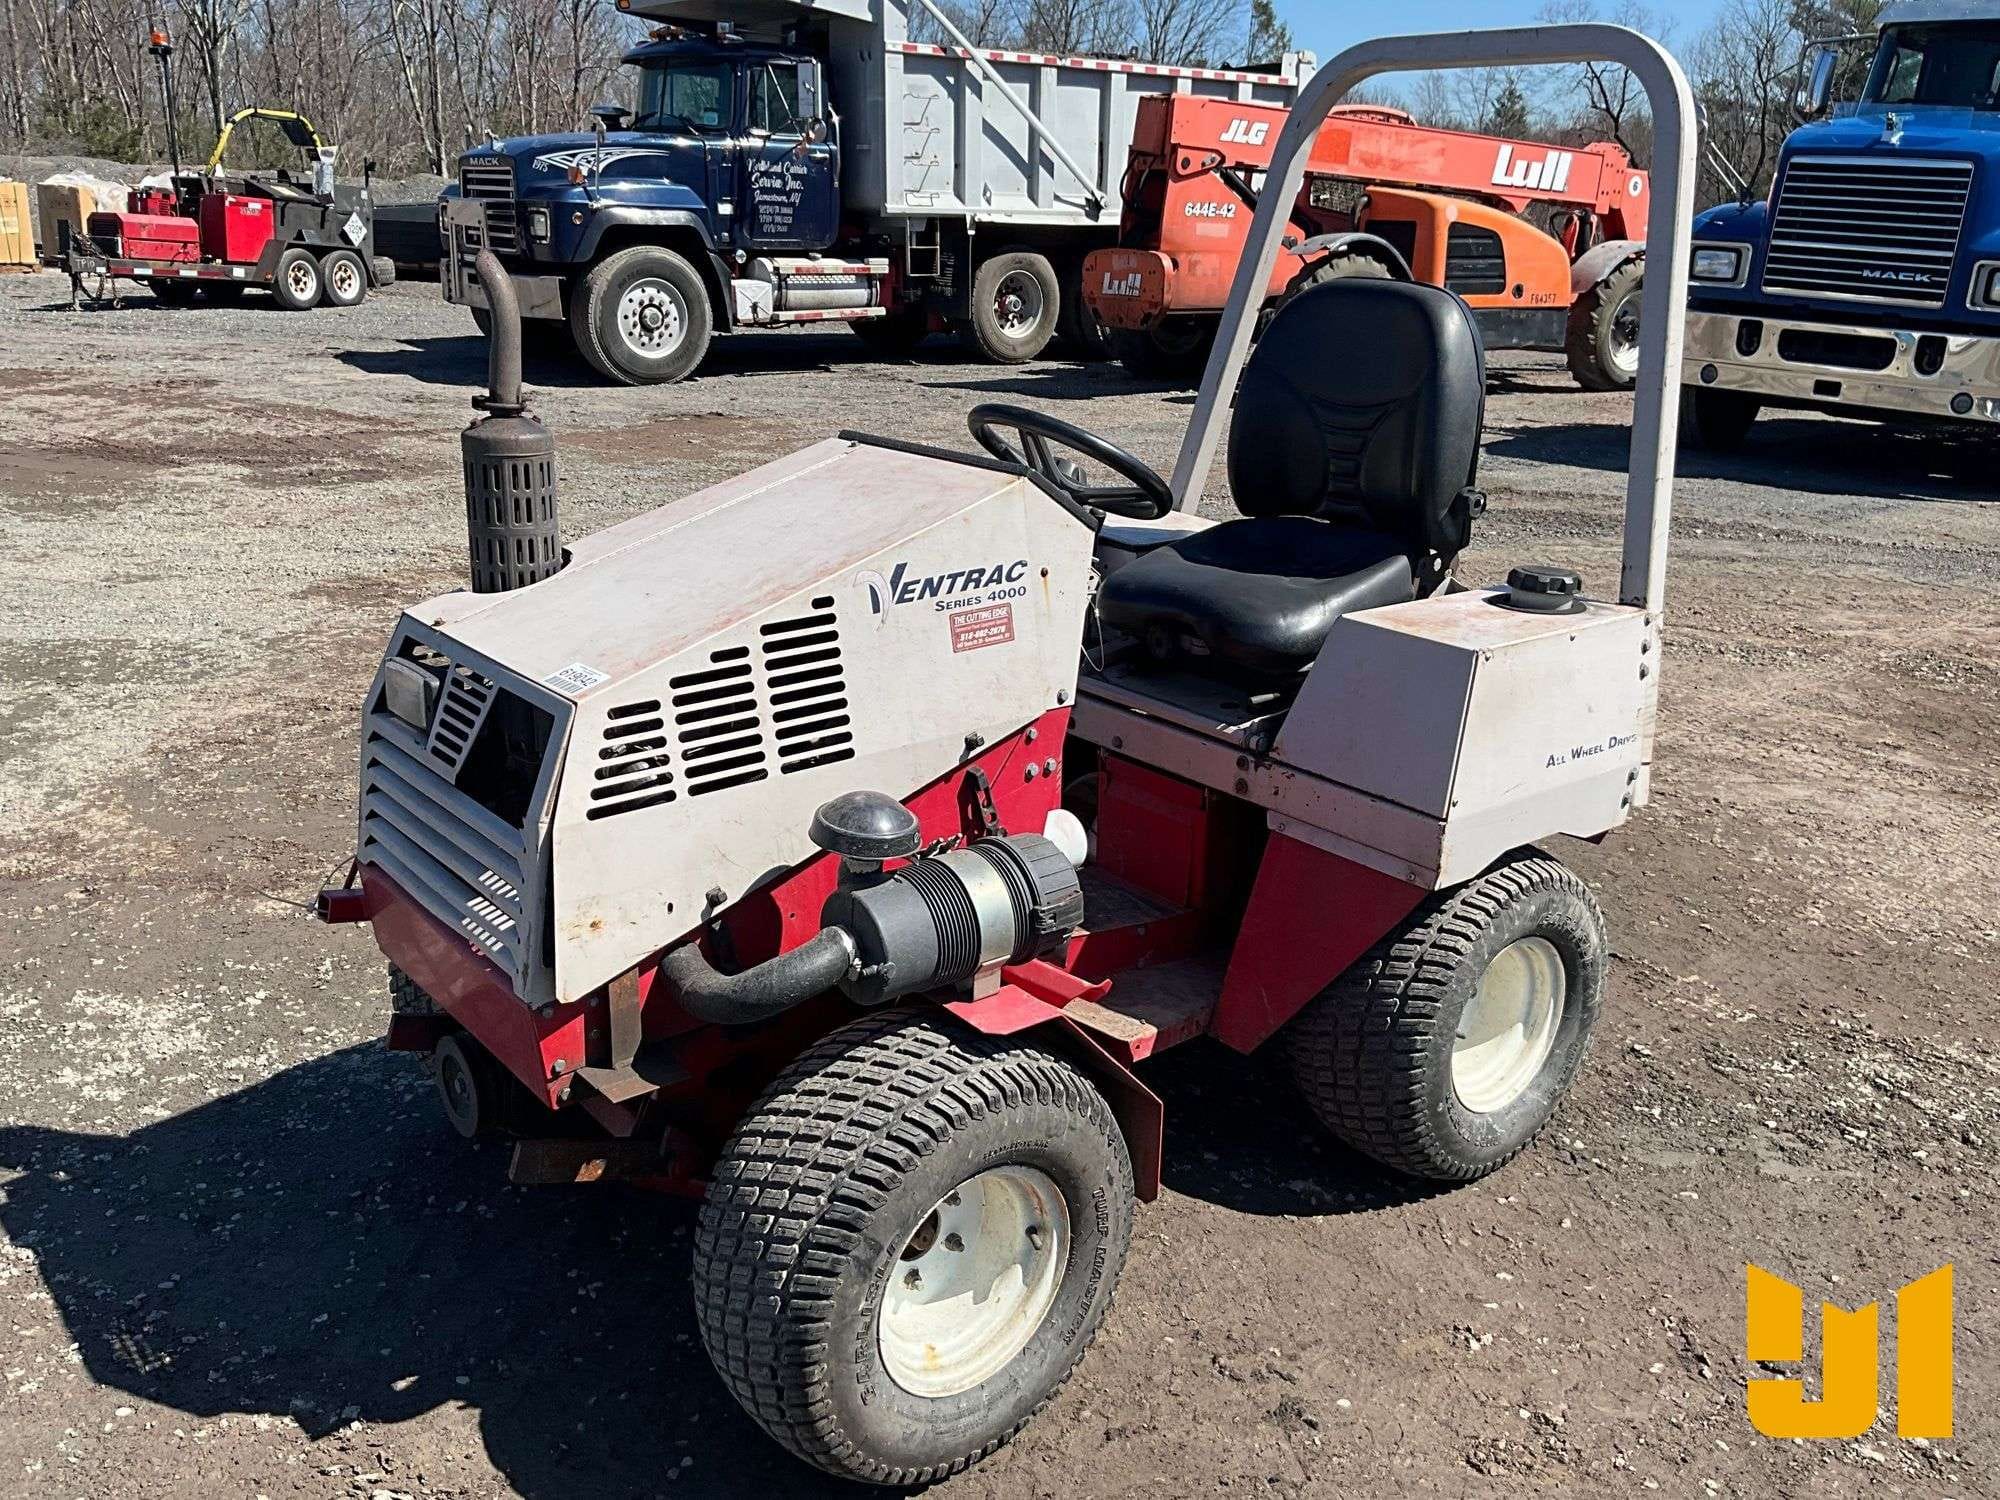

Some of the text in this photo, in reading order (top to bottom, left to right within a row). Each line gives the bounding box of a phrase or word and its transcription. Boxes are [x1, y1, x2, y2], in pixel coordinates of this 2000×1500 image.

[1219, 119, 1271, 146] JLG
[469, 157, 500, 166] MACK
[532, 158, 549, 173] 1975
[1491, 143, 1573, 192] Lull
[785, 174, 804, 191] Inc.
[1184, 201, 1236, 219] 644E-42
[1102, 271, 1142, 297] Lull
[1862, 269, 1932, 283] MACK
[867, 559, 1029, 615] VENTRAC
[934, 585, 1027, 612] SERIES 4000
[1571, 744, 1605, 759] WHEEL
[1092, 1185, 1110, 1239] TURF
